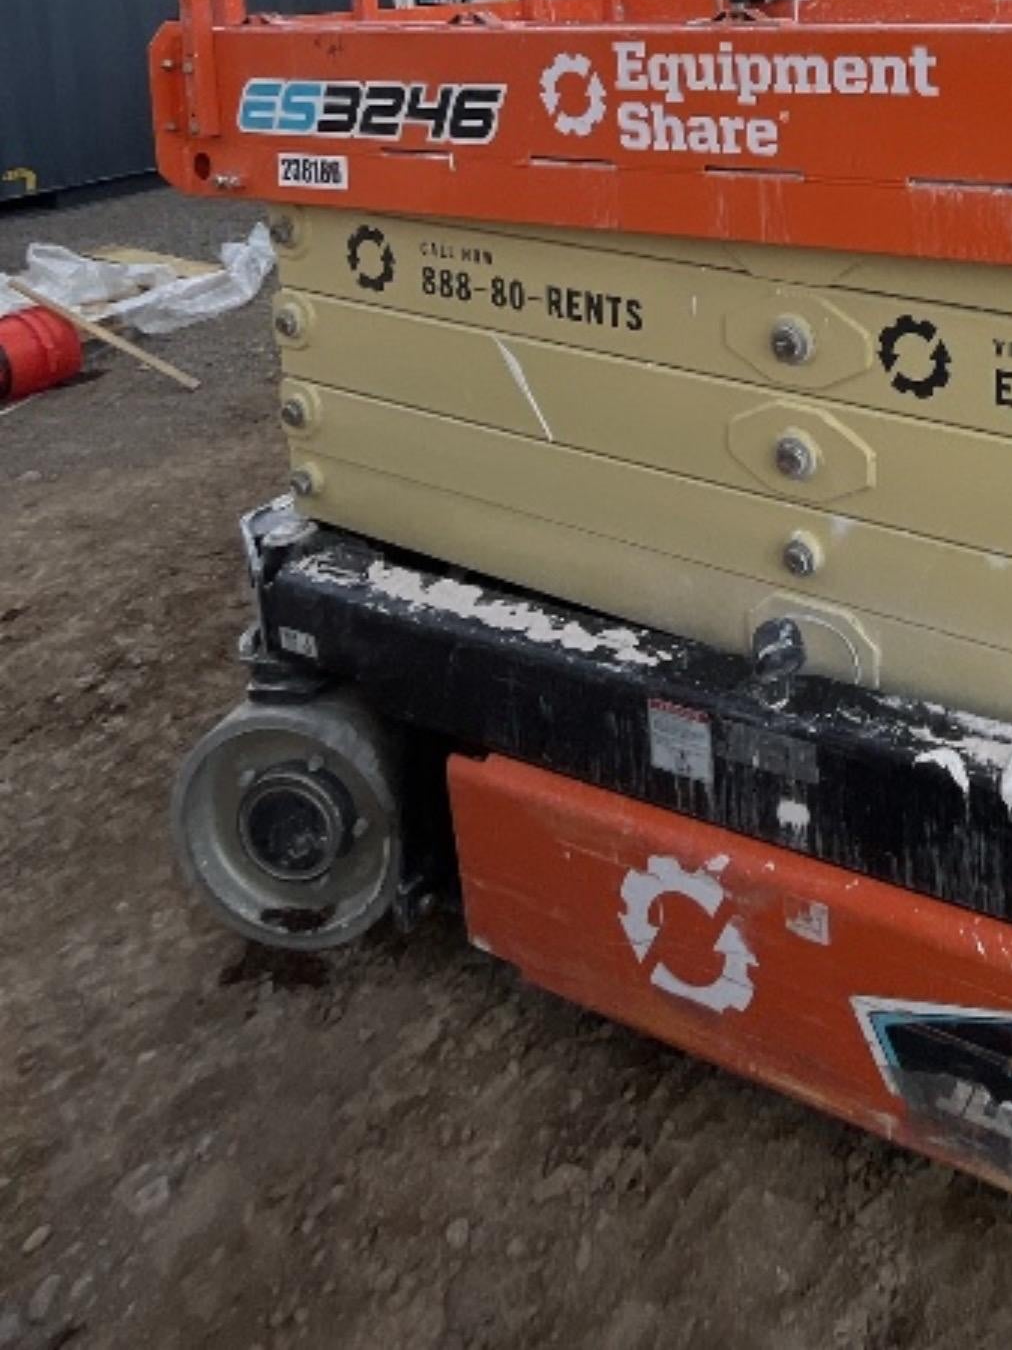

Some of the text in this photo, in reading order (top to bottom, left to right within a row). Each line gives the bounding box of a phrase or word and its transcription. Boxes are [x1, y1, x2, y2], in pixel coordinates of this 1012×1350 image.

[612, 41, 940, 105] Equipment
[237, 78, 507, 144] ES3246
[421, 266, 644, 331] 888-80-RENTS
